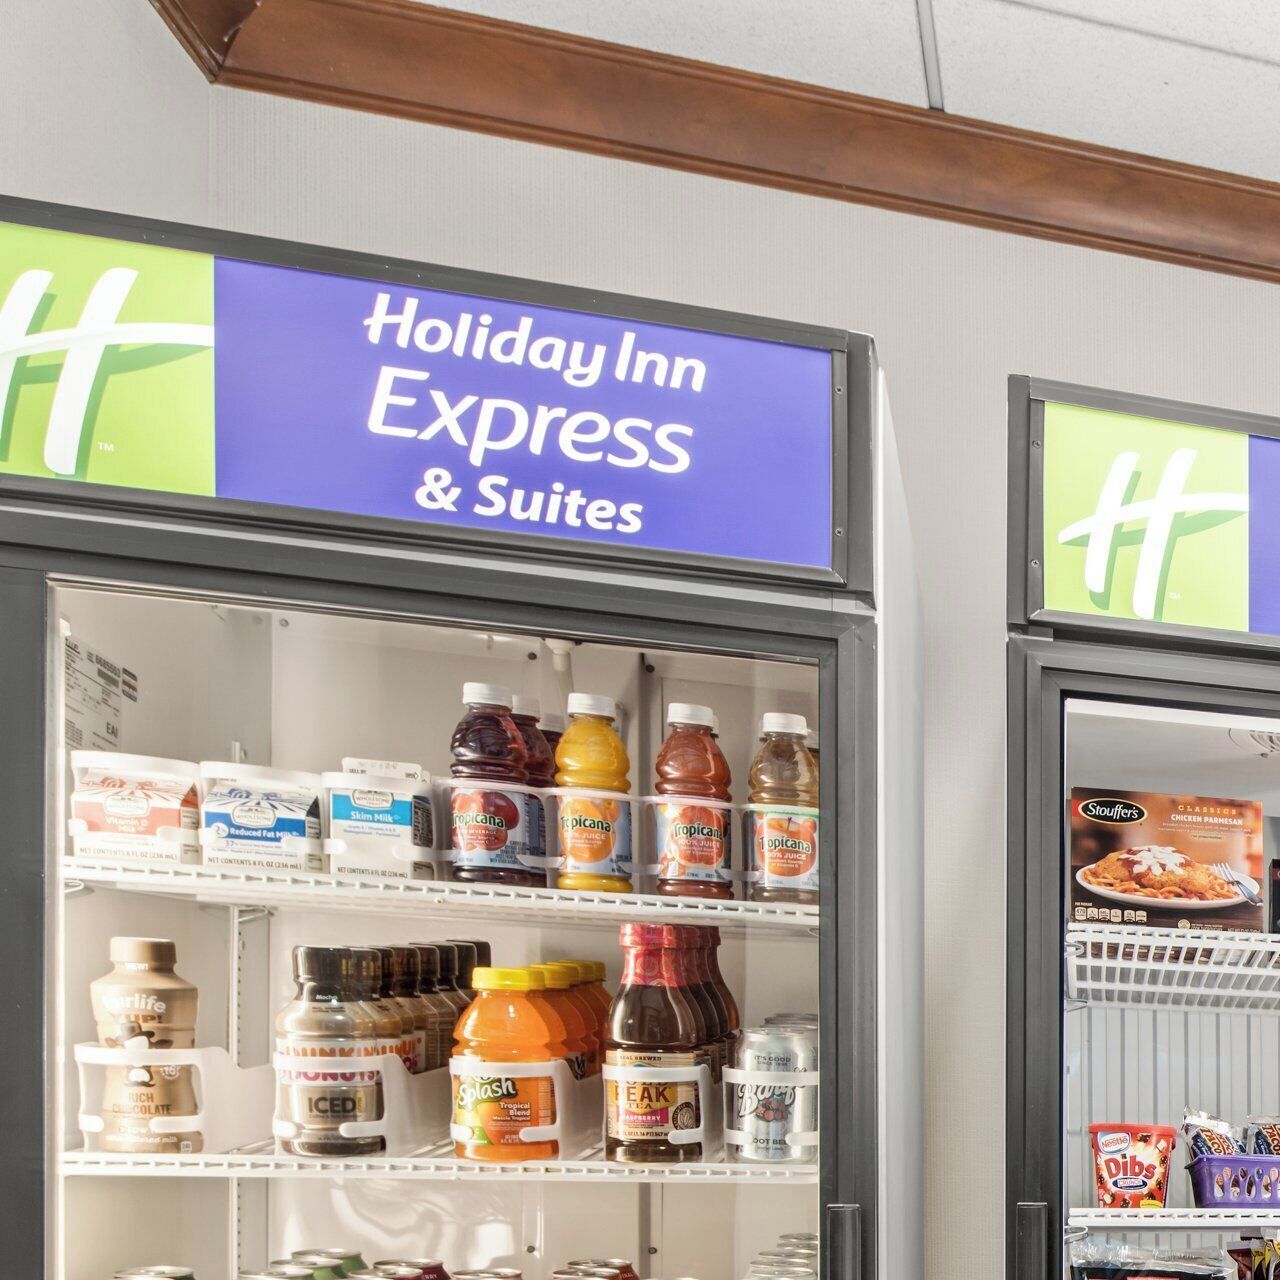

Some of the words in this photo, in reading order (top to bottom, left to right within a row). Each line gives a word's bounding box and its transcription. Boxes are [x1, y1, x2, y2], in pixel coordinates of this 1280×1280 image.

[364, 294, 606, 390] Holiday
[614, 331, 707, 393] Inn
[368, 367, 694, 475] Express
[414, 469, 458, 512] &
[473, 474, 643, 534] Suites
[1087, 802, 1139, 820] Stouffer's
[1178, 805, 1237, 815] CLASSICS
[351, 811, 371, 822] Skim
[373, 812, 393, 823] Milk
[1171, 814, 1202, 823] CHICKEN
[1204, 816, 1243, 825] PARMESAN
[230, 828, 261, 836] Reduced
[582, 832, 606, 841] JUICE
[674, 822, 723, 839] Tropicana
[784, 852, 806, 861] JUICE
[458, 1079, 516, 1107] Splash
[499, 1102, 531, 1111] Tropical
[509, 1108, 531, 1116] Blend
[1104, 1154, 1156, 1179] Dibs
